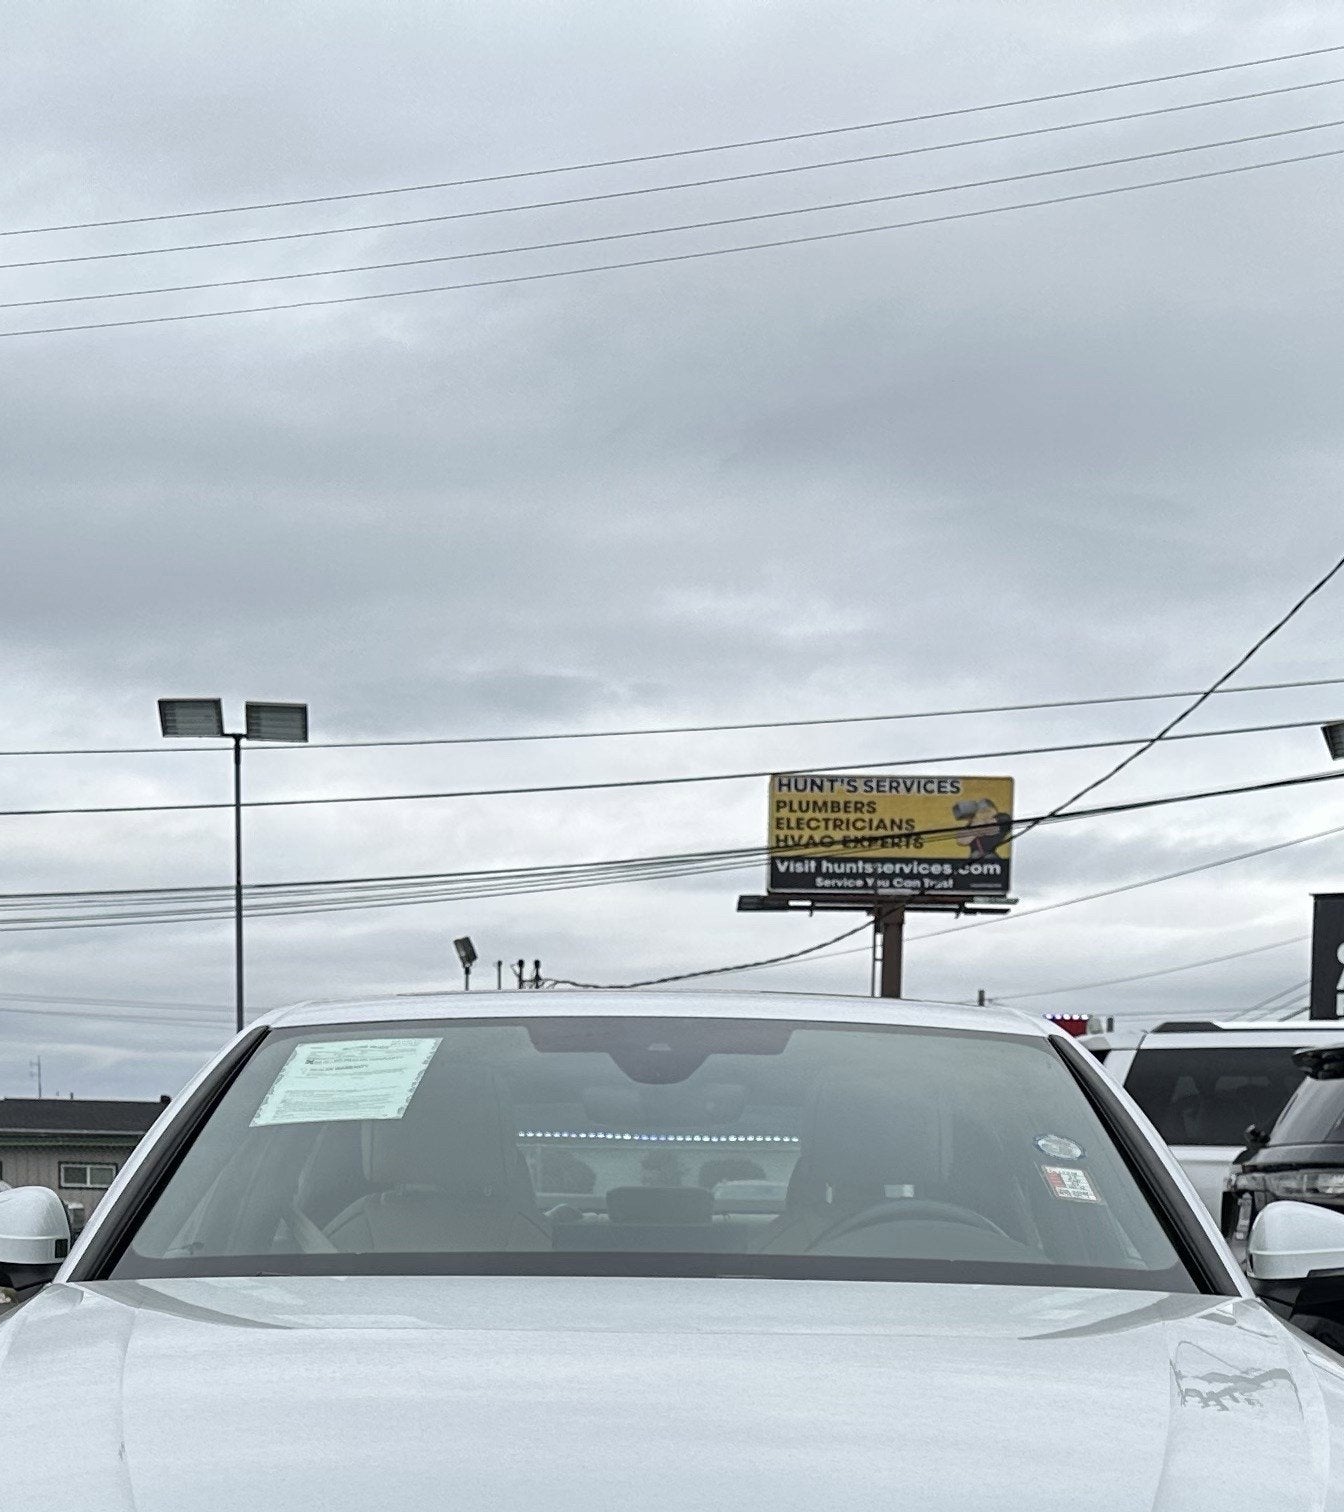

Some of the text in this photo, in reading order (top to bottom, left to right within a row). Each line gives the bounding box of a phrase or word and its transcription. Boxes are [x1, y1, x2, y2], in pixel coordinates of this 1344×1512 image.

[777, 778, 961, 795] HUNT'S SERVICES
[775, 800, 877, 814] PLUMBERS
[775, 817, 916, 832] ELECTRICIANS
[776, 860, 815, 873] Visit
[815, 877, 864, 887] Service
